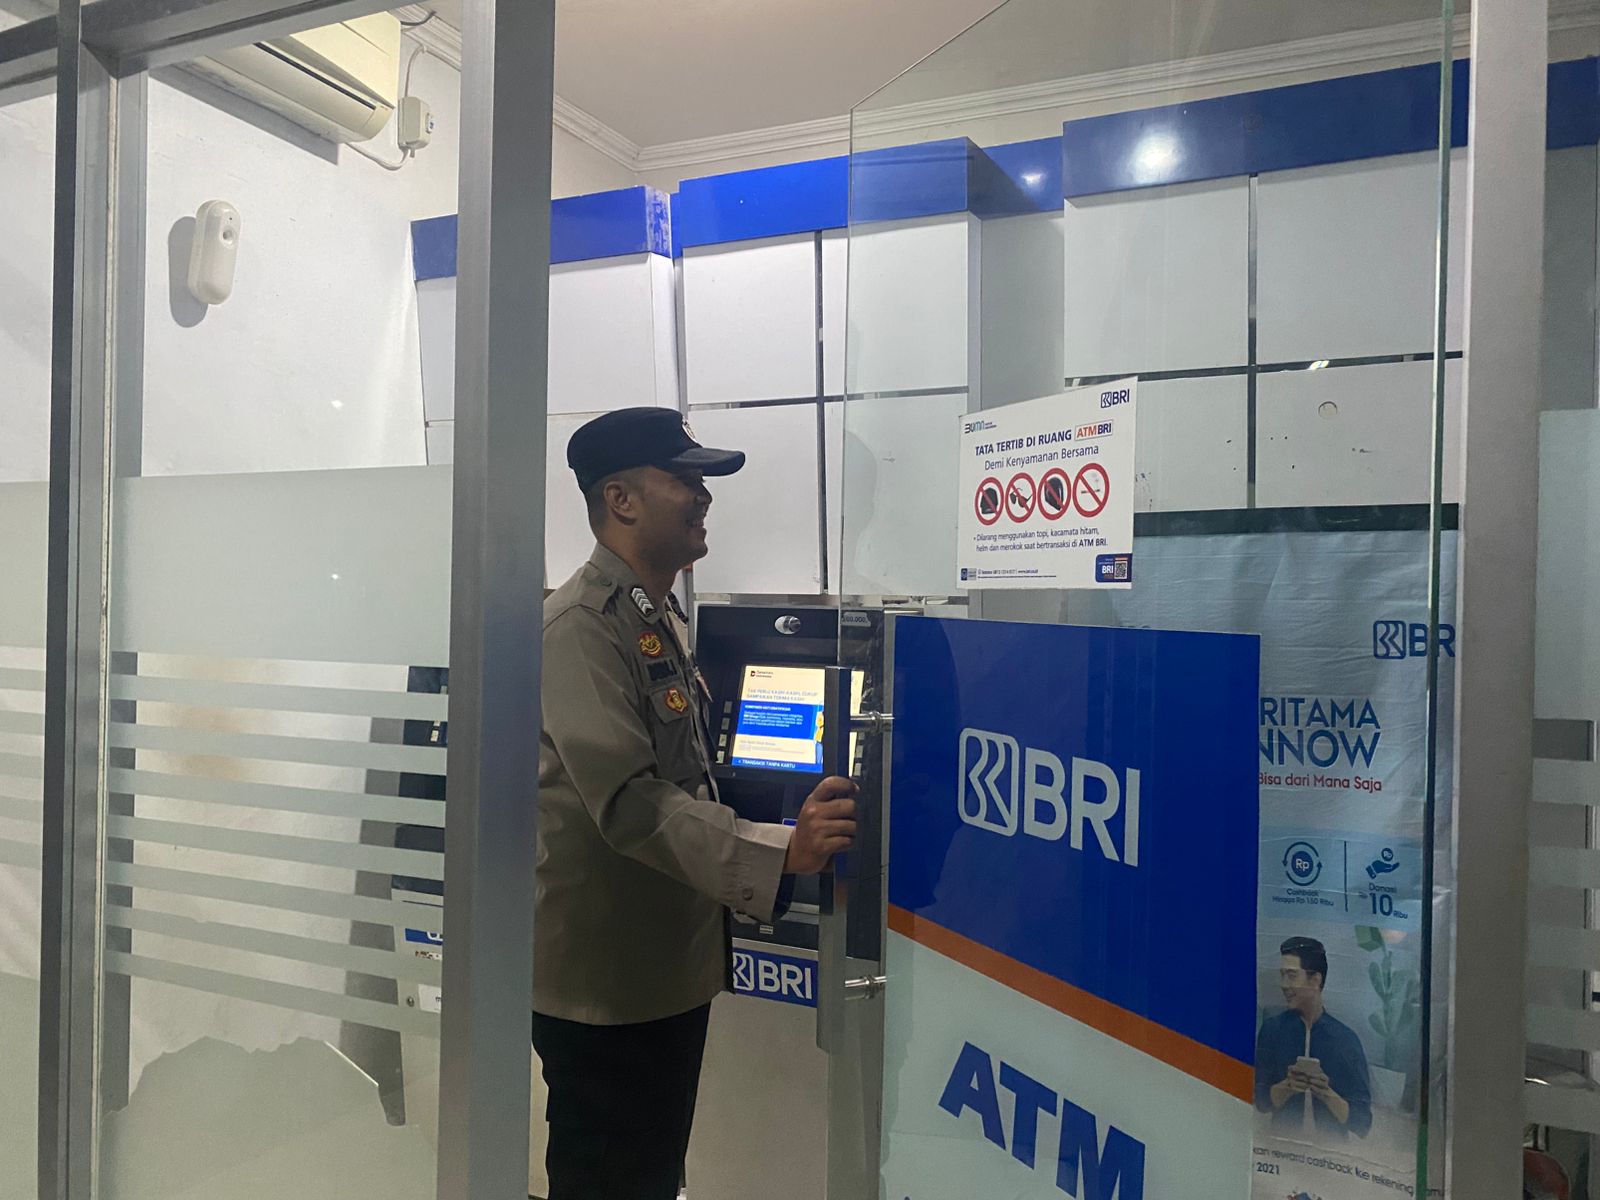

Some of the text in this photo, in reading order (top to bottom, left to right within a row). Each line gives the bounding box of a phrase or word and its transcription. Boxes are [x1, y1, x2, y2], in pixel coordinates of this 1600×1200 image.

[1112, 388, 1130, 406] BRI
[975, 443, 994, 457] TATA
[996, 438, 1024, 453] TERTIB
[1026, 435, 1036, 447] DI
[1038, 430, 1072, 446] RUANG
[984, 445, 1099, 471] Demi Kenyamanan Bersama
[976, 526, 1100, 542] Dilarang menggunakan topi, kacamata hitam,
[976, 544, 988, 552] helm
[1000, 542, 1023, 551] merokok
[1023, 542, 1036, 550] saat
[1036, 539, 1071, 549] bertransaksi
[1071, 538, 1078, 547] di
[1079, 538, 1094, 548] ATM
[1101, 565, 1114, 574] BRI
[780, 761, 796, 769] KARTU
[1258, 772, 1382, 794] Bisa dari Mana Saja
[1023, 746, 1141, 868] BRI
[1295, 858, 1310, 872] Rp
[1368, 882, 1396, 893] Donasi
[1369, 892, 1393, 917] 10
[757, 958, 813, 1000] BRI
[937, 1040, 1146, 1200] ATM
[1256, 1162, 1280, 1175] 2021
[1270, 1150, 1306, 1164] reward
[1306, 1155, 1353, 1176] cashback
[1354, 1166, 1370, 1180] ke
[1371, 1173, 1415, 1197] rekening
